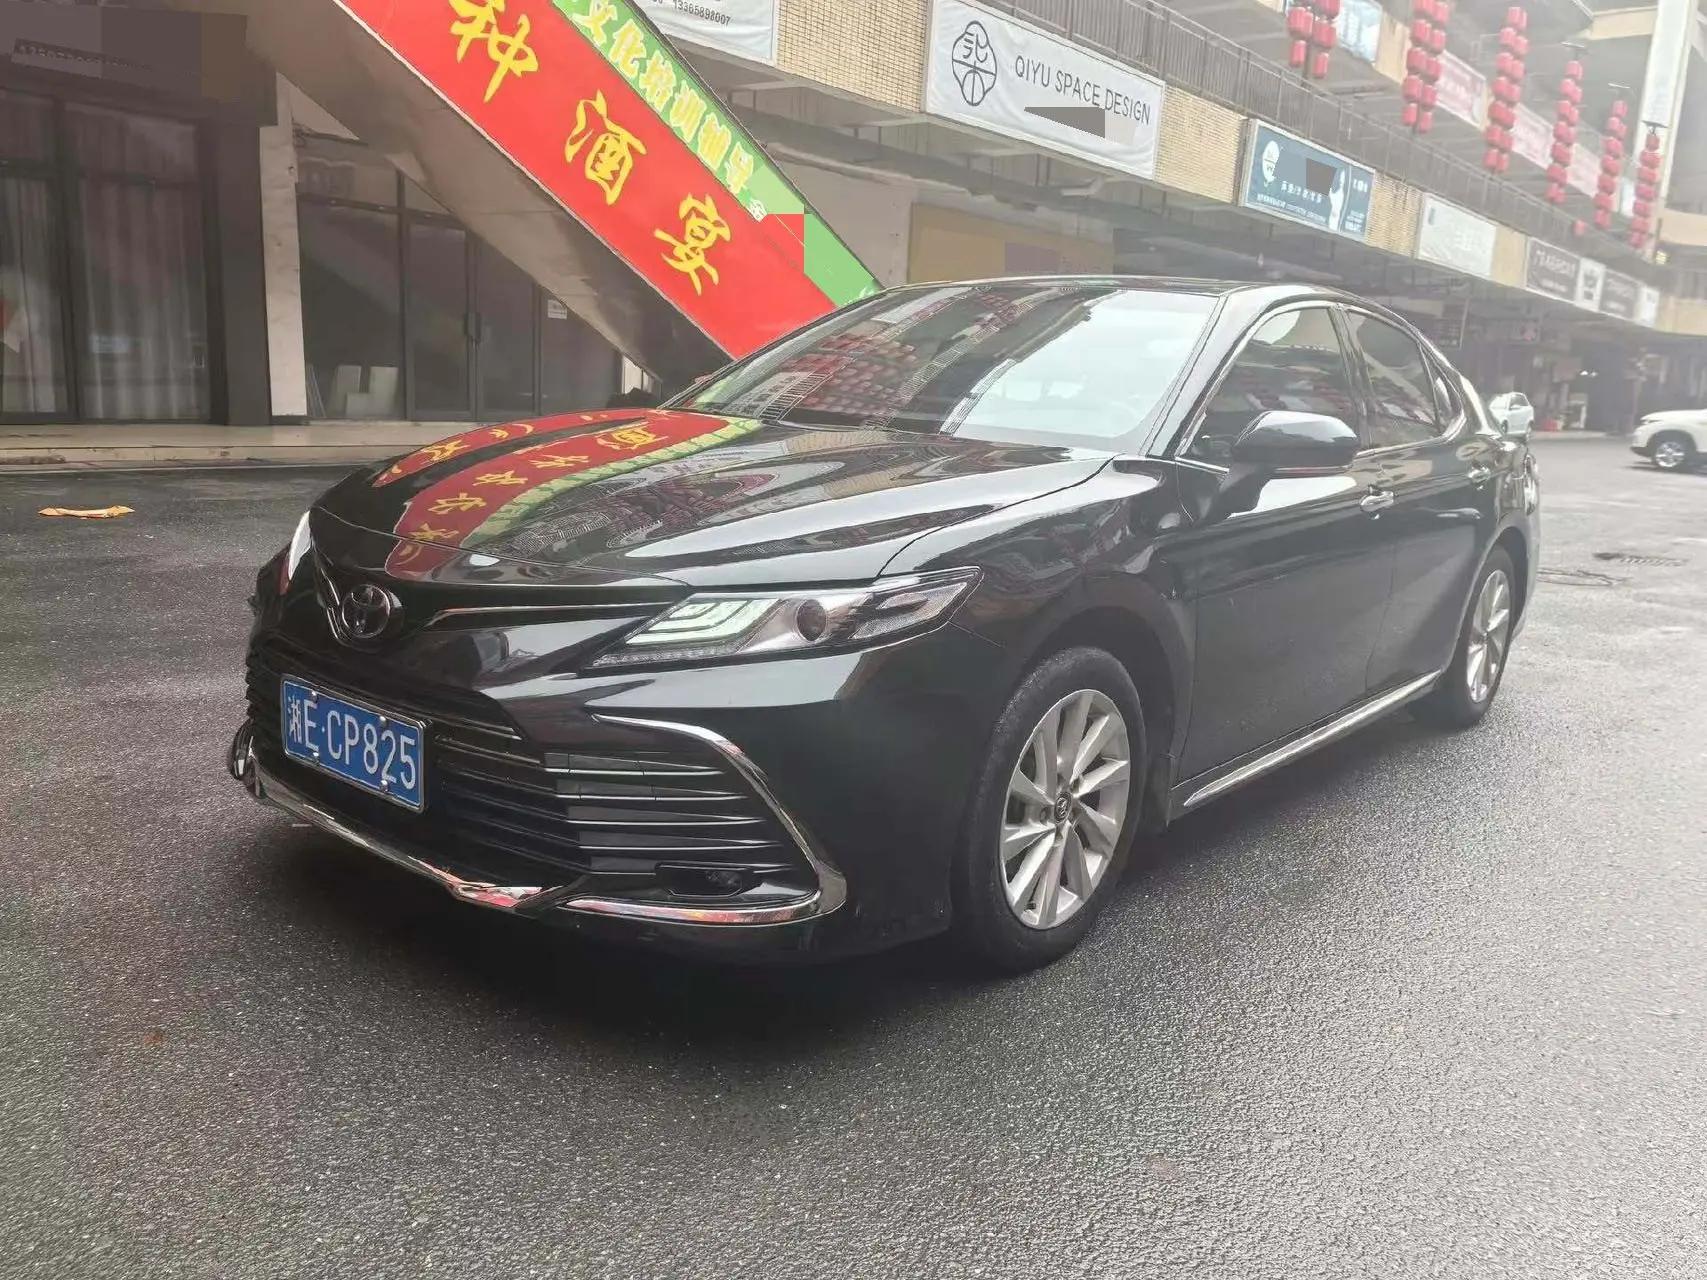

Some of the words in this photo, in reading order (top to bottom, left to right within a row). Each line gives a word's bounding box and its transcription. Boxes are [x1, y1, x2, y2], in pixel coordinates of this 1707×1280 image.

[1015, 55, 1051, 88] QIYU
[1055, 70, 1101, 106] SPACE
[1104, 88, 1151, 126] DESIGN
